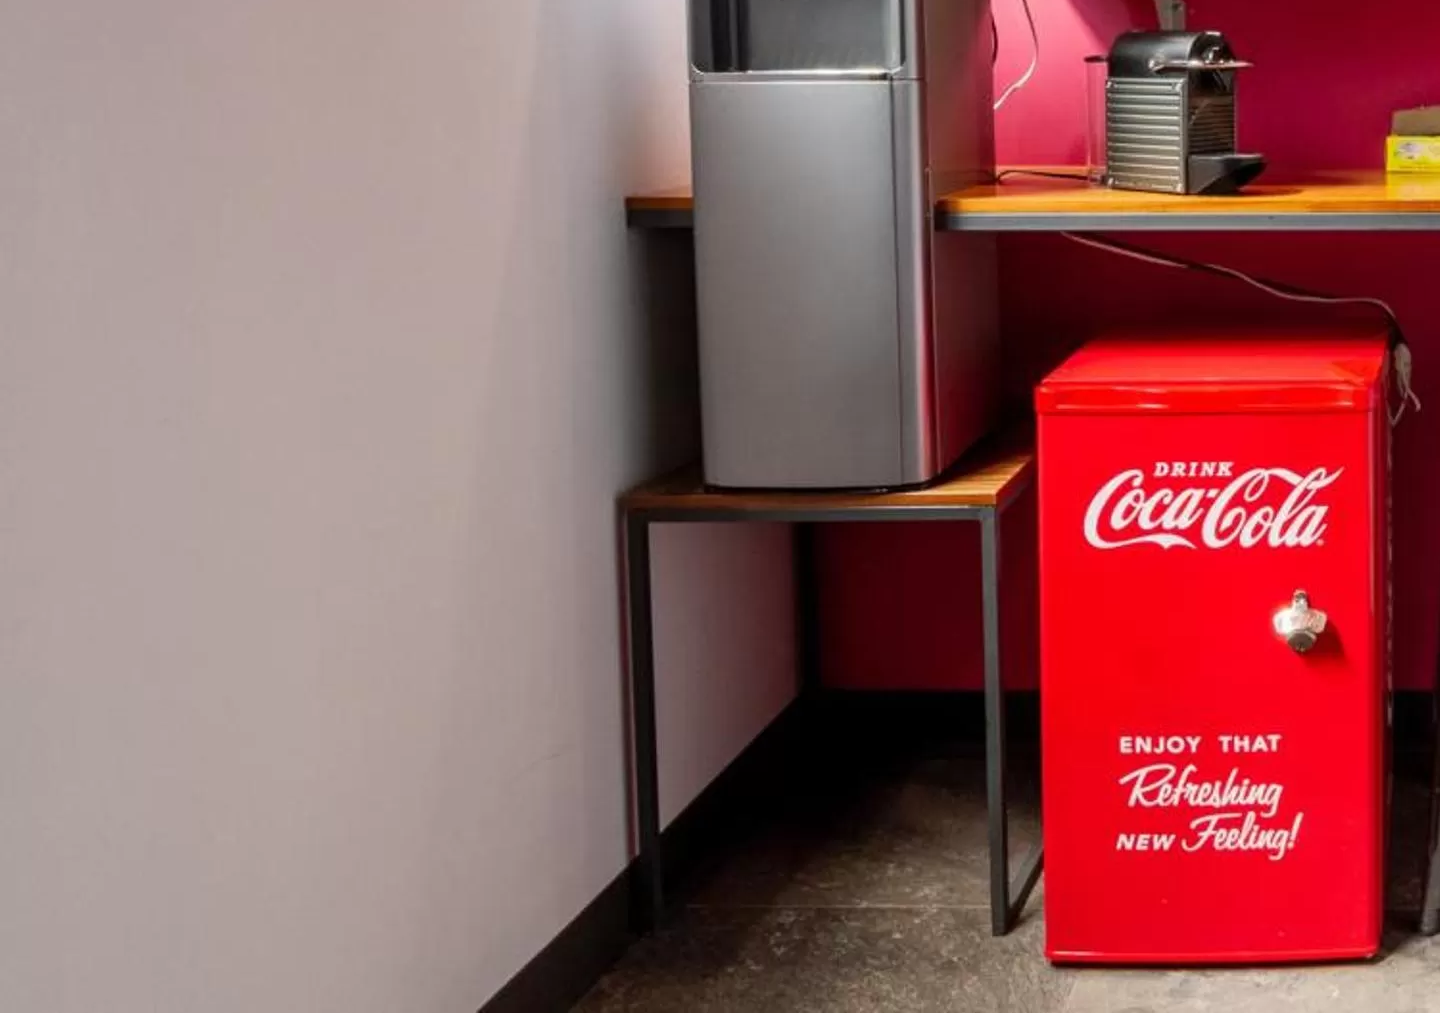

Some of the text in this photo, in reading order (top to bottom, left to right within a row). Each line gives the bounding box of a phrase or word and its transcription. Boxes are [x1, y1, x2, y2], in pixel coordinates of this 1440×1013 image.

[1153, 461, 1234, 478] DRINK
[1083, 465, 1343, 549] Coca-Cola
[1119, 734, 1282, 754] ENJOY THAT
[1119, 763, 1284, 819] Refreshing
[1116, 811, 1304, 861] NEW Feeling!
